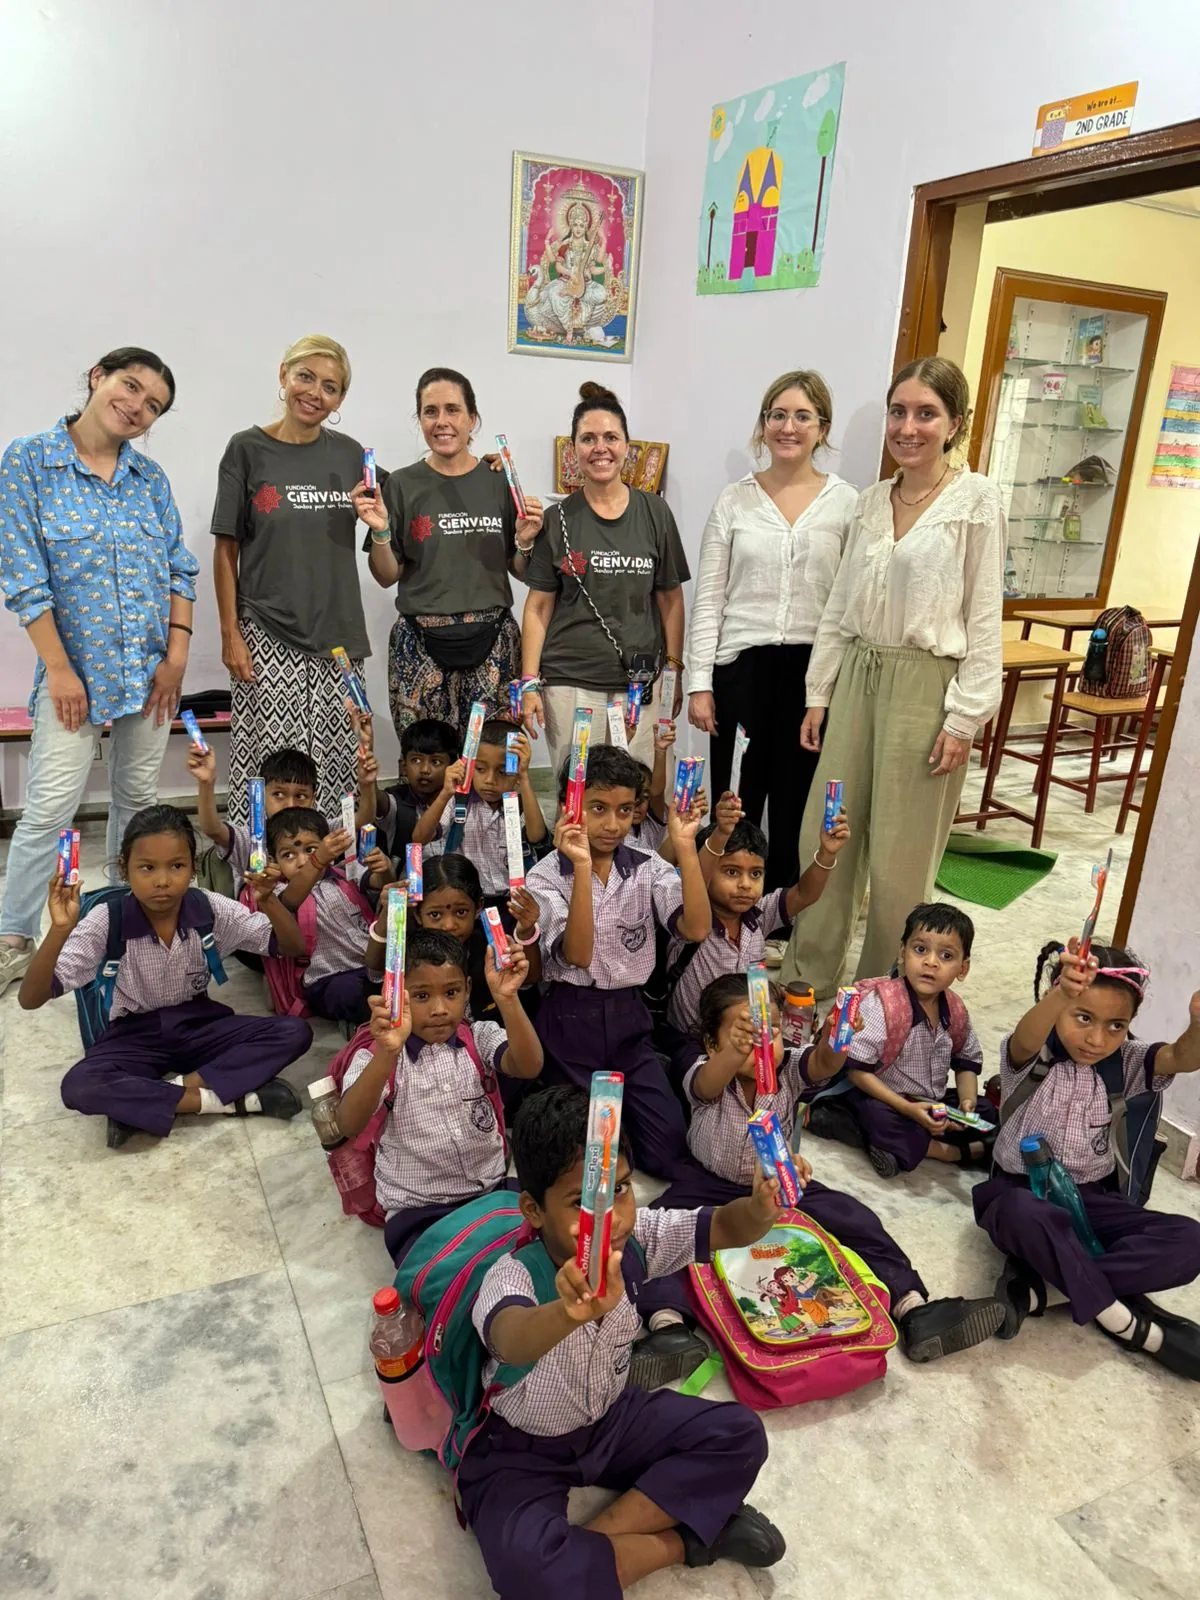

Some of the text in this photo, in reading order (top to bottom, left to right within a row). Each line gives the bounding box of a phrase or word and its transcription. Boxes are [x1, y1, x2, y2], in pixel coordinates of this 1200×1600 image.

[1075, 110, 1129, 136] 2ND GRADE
[438, 511, 469, 519] FUNDACIÓN
[850, 995, 860, 1023] Colgate
[780, 1165, 796, 1204] Colgate
